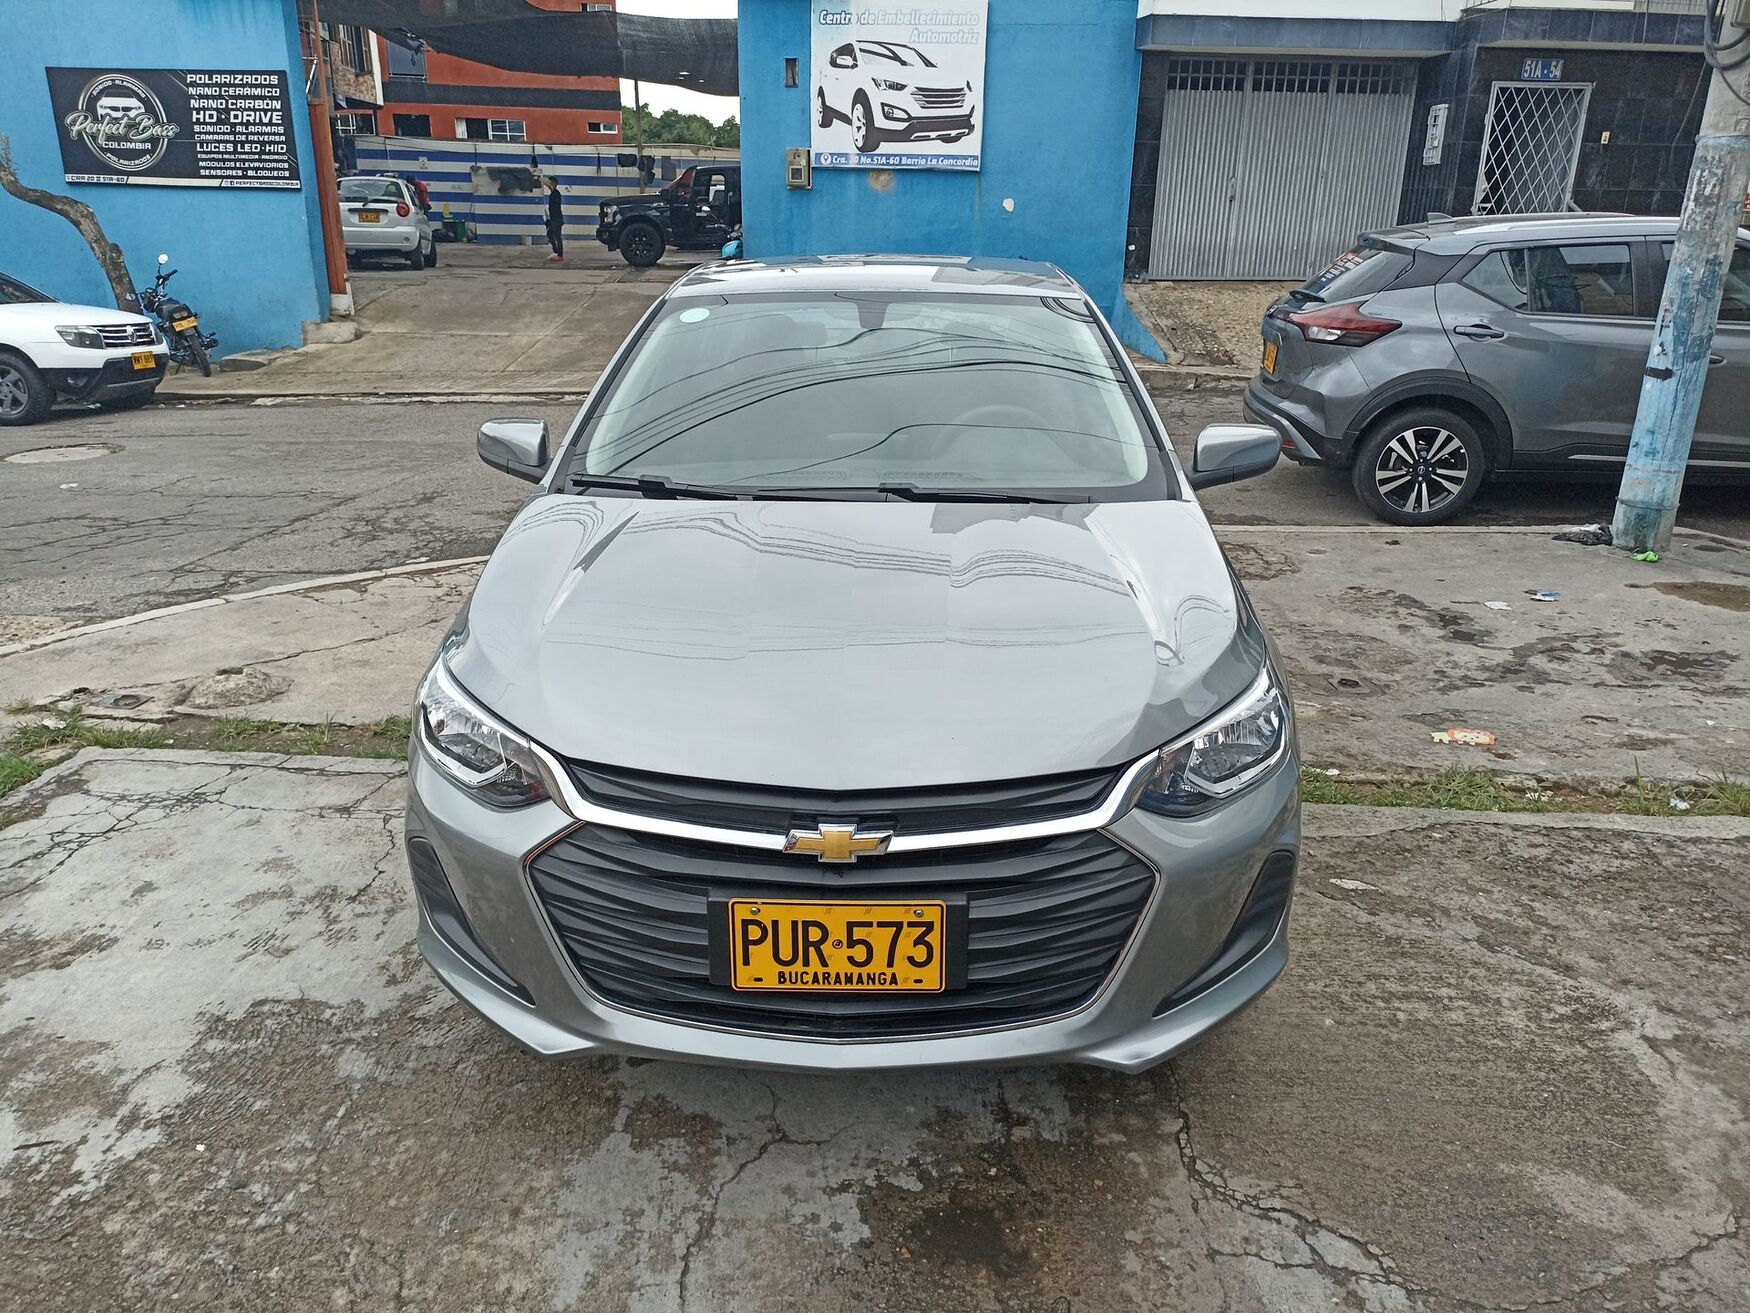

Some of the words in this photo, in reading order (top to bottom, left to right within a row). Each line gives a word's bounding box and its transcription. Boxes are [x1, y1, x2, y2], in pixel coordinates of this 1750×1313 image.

[860, 10, 875, 25] de
[876, 10, 979, 26] Embellecimiento
[910, 27, 979, 44] Automotriz
[1523, 60, 1542, 78] 51A
[1549, 60, 1563, 78] 54
[186, 74, 279, 85] POLARIZADOS
[92, 80, 112, 97] SONIDO
[188, 87, 220, 96] NANO
[221, 86, 280, 97] CERÁMICO
[190, 99, 226, 108] NANO
[228, 98, 281, 109] CARBÓN
[192, 110, 217, 122] HD
[229, 111, 283, 124] DRIVE
[65, 111, 129, 145] Perfect
[128, 112, 180, 141] Bass
[193, 124, 231, 133] SONIDO
[236, 125, 285, 134] ALARMAS
[102, 141, 152, 150] COLOMBIA
[196, 143, 234, 152] LUCES
[237, 143, 261, 152] LED
[265, 144, 287, 153] HID
[105, 152, 151, 166] POLARIZADOS
[832, 156, 848, 164] Cra.
[901, 156, 926, 166] Barrio
[927, 156, 938, 165] La
[938, 156, 979, 167] Concordia
[200, 169, 242, 177] SENSORES
[247, 170, 290, 178] BLOQUEOS
[741, 918, 830, 968] PUR
[846, 920, 935, 969] 573
[777, 970, 899, 986] BUCARAMANGA
